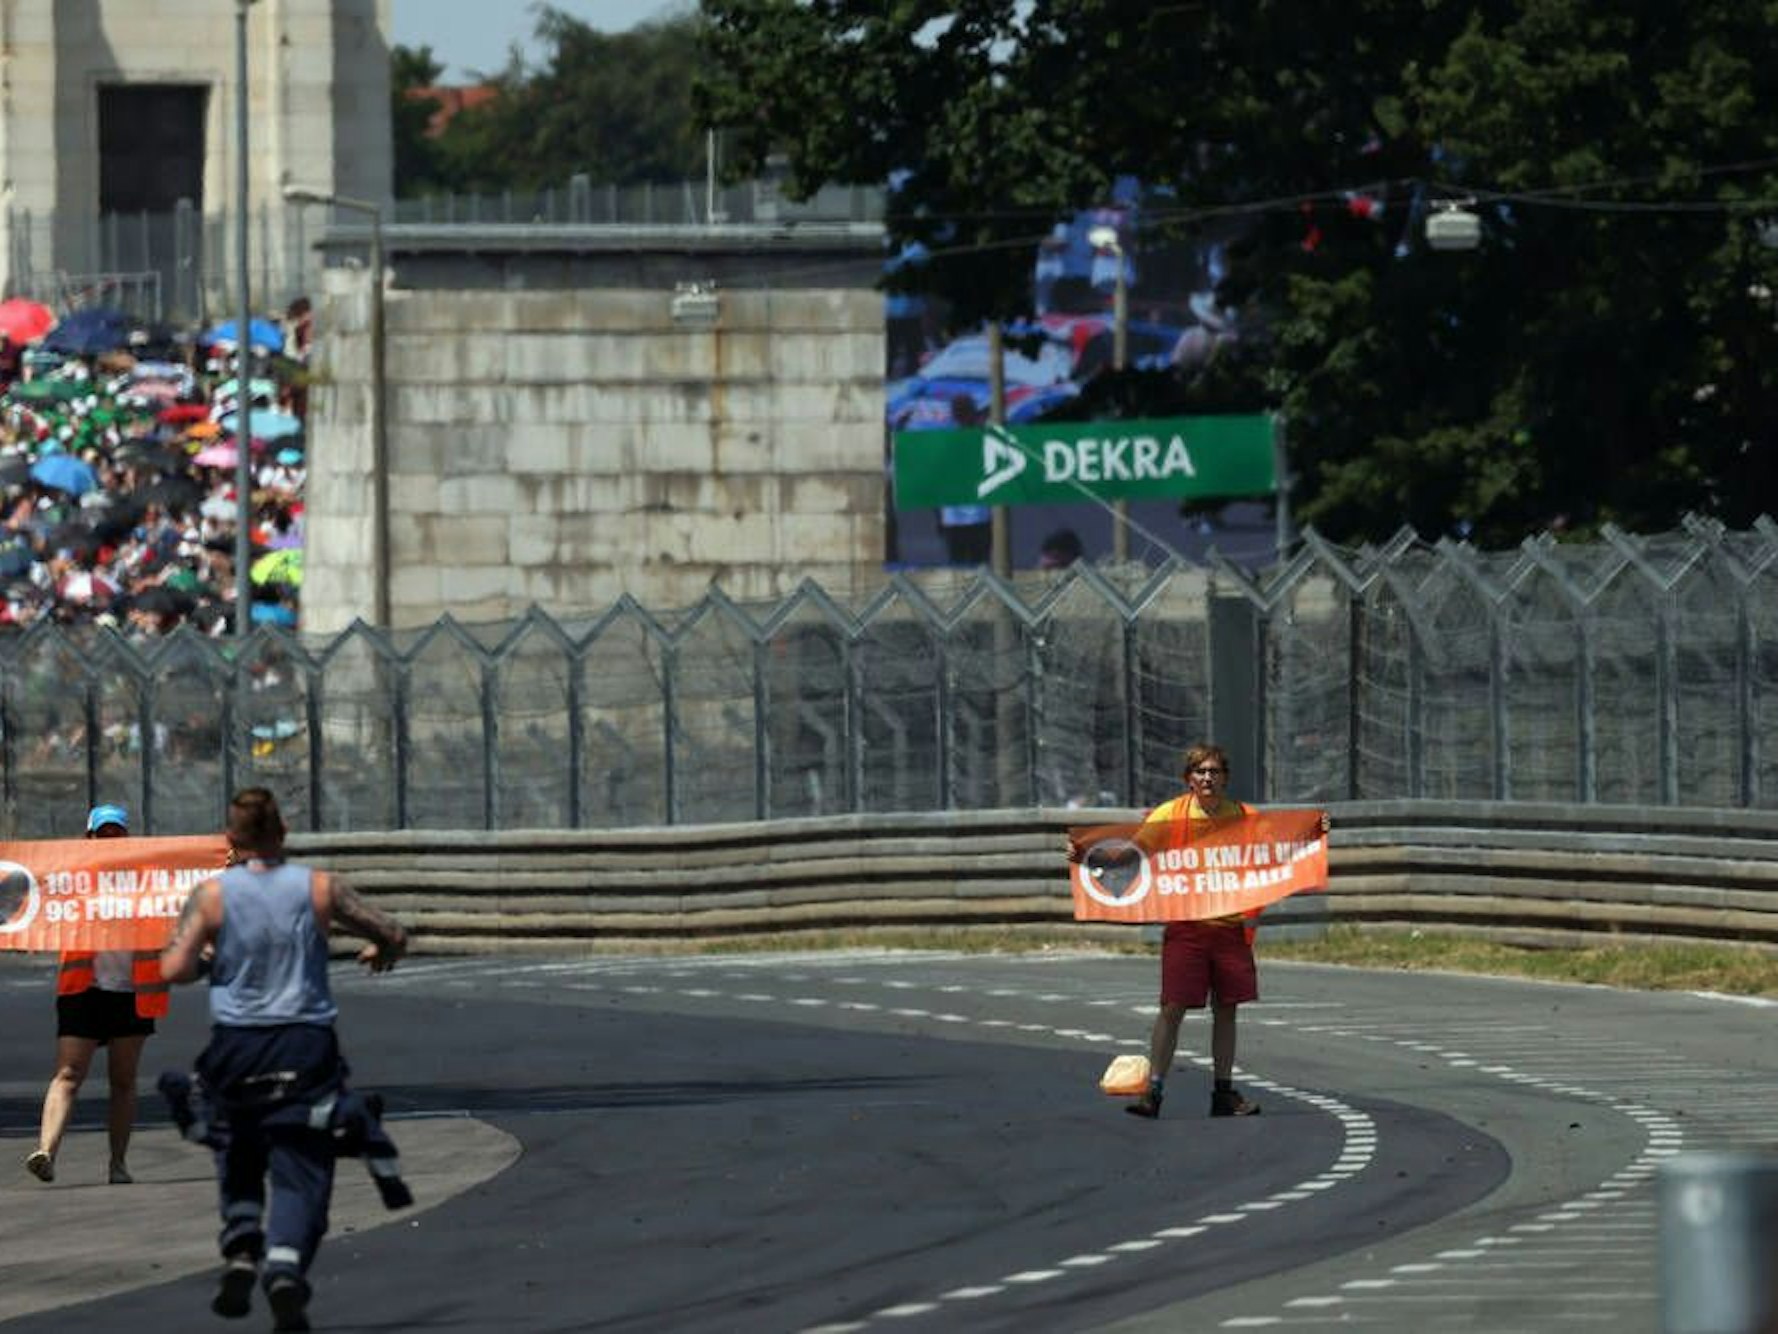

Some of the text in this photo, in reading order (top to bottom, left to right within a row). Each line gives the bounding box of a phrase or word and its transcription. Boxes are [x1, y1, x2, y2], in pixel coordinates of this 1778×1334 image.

[1043, 434, 1196, 483] DEKRA
[1157, 847, 1199, 872] 100
[1203, 842, 1271, 867] KM/H
[45, 867, 226, 895] 100 KM/H UN
[1194, 869, 1240, 894] FÜR
